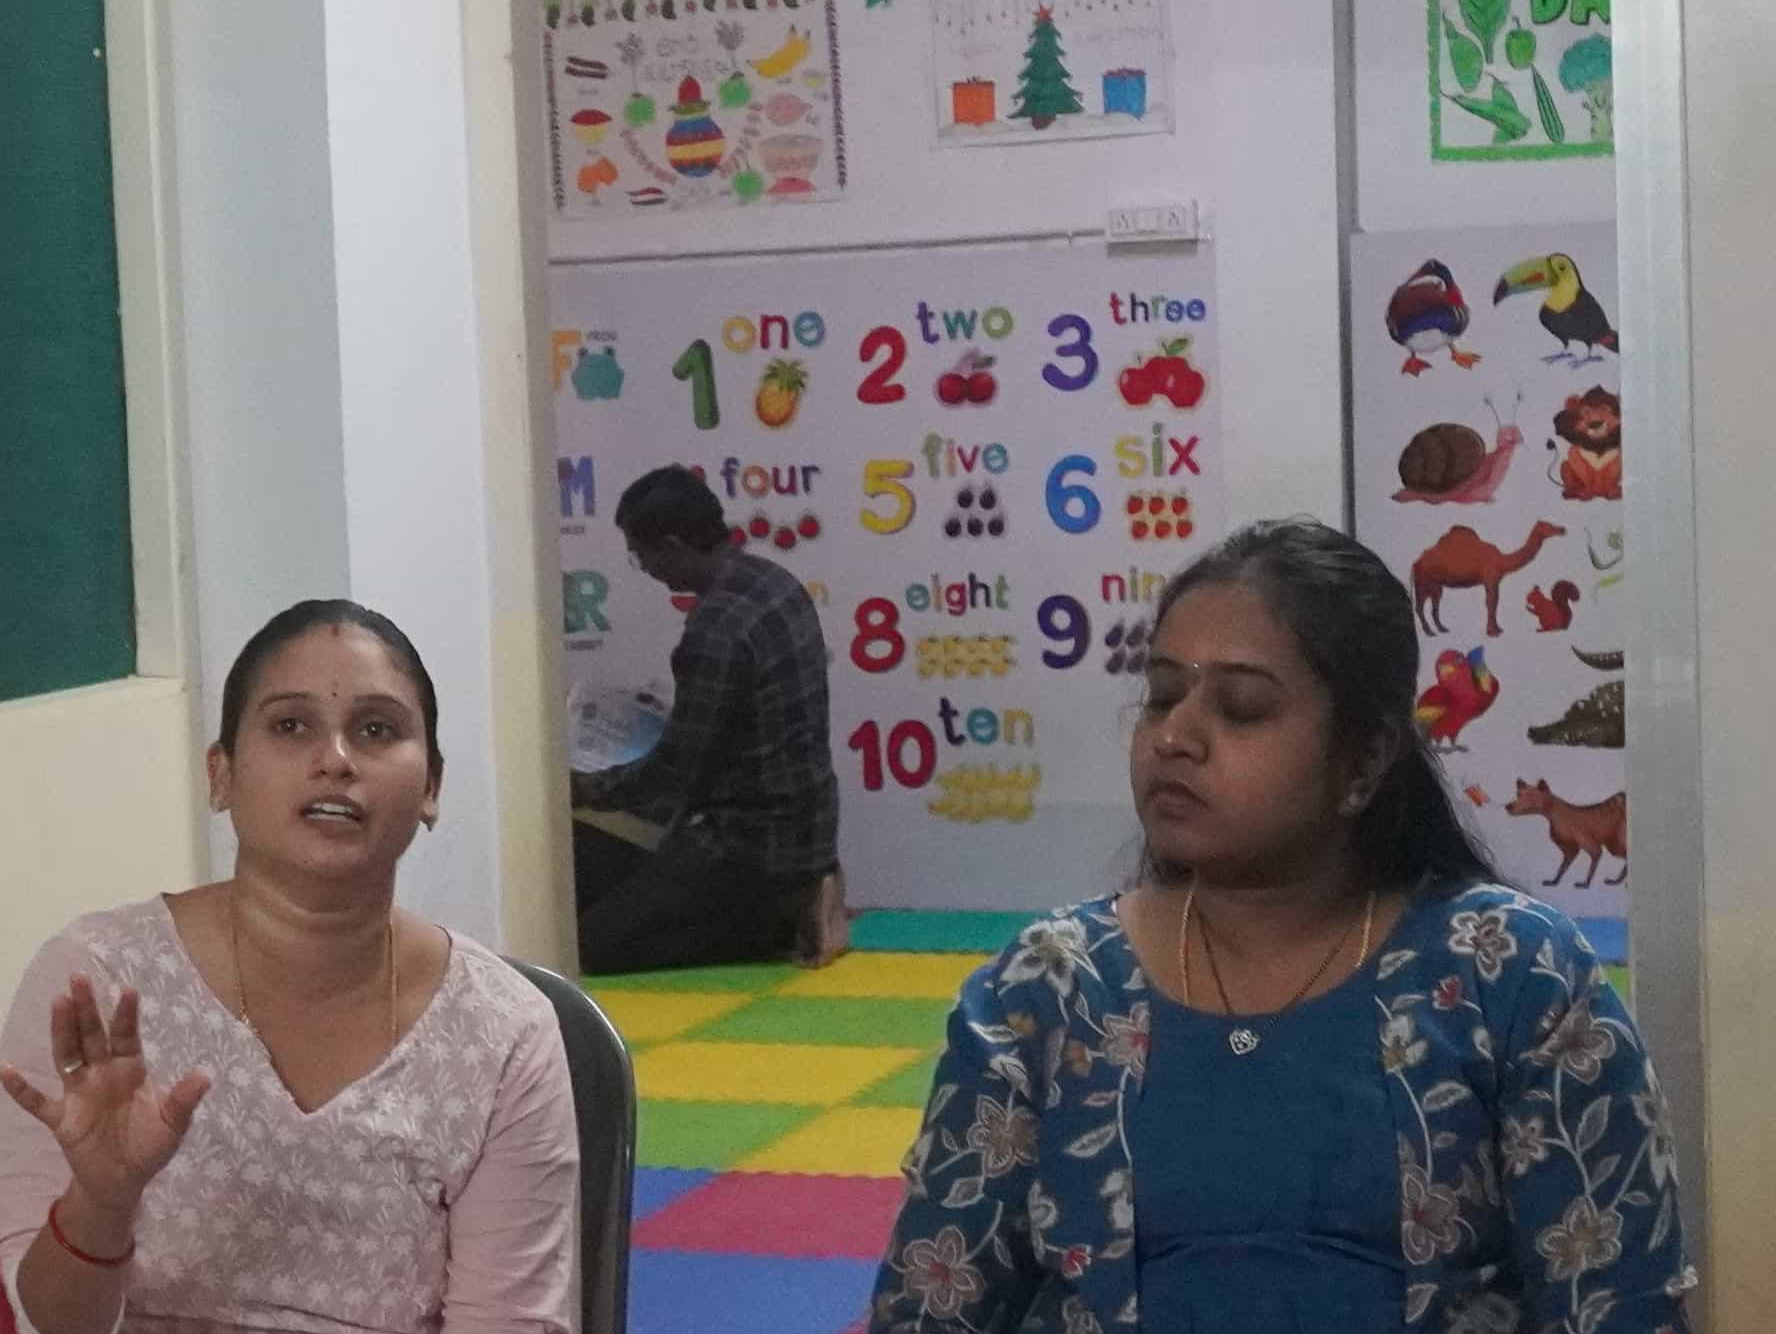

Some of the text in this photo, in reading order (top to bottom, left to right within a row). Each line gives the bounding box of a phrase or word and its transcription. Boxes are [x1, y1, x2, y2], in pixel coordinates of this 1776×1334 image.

[672, 312, 825, 430] 1 one
[857, 301, 1014, 405] 2 two
[1042, 292, 1206, 401] 3 three
[558, 455, 595, 517] M
[721, 457, 820, 499] four
[859, 432, 1009, 534] 5 five
[1045, 422, 1201, 544] 6 six
[562, 571, 611, 633] R
[850, 573, 1010, 673] 8 eight
[1037, 567, 1168, 669] 9 nin
[848, 697, 1035, 791] 10 ten
